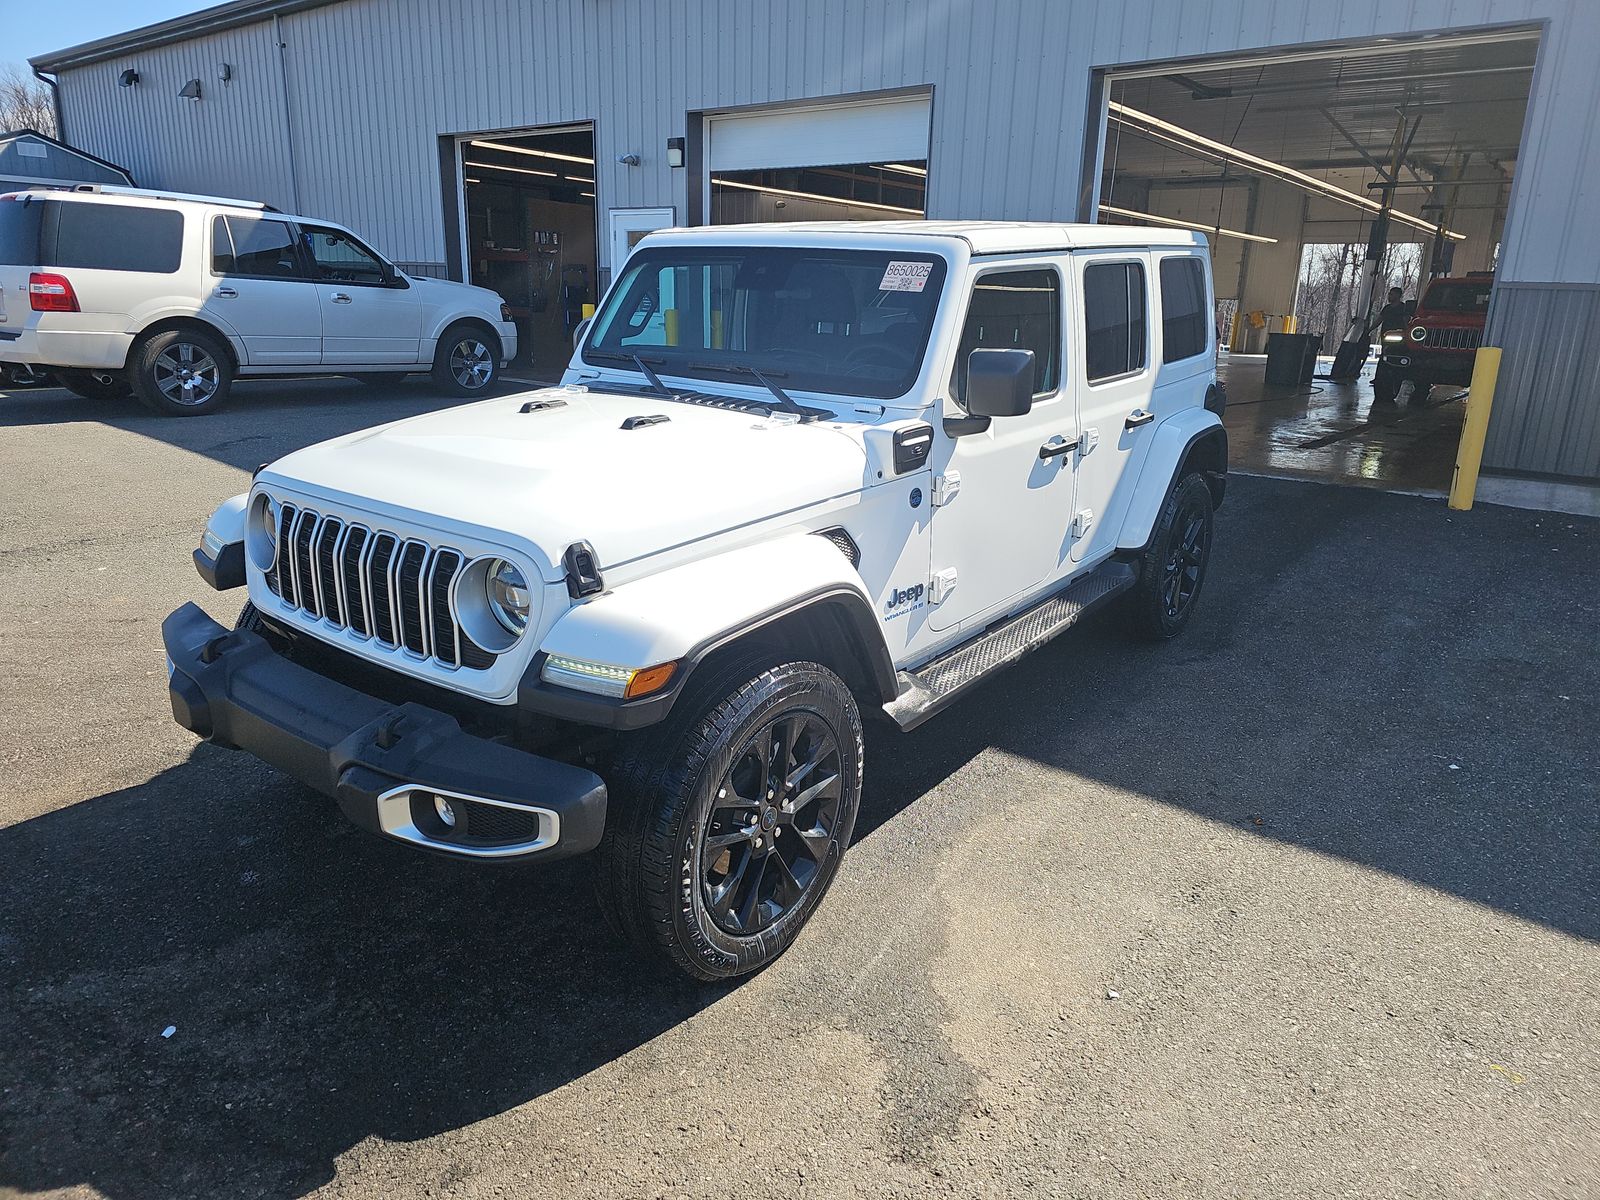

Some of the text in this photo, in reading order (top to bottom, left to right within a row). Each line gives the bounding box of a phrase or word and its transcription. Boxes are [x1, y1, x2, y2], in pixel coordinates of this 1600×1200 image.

[887, 264, 931, 277] 8650025
[886, 583, 924, 609] Jeep
[884, 604, 918, 622] WRANGLER
